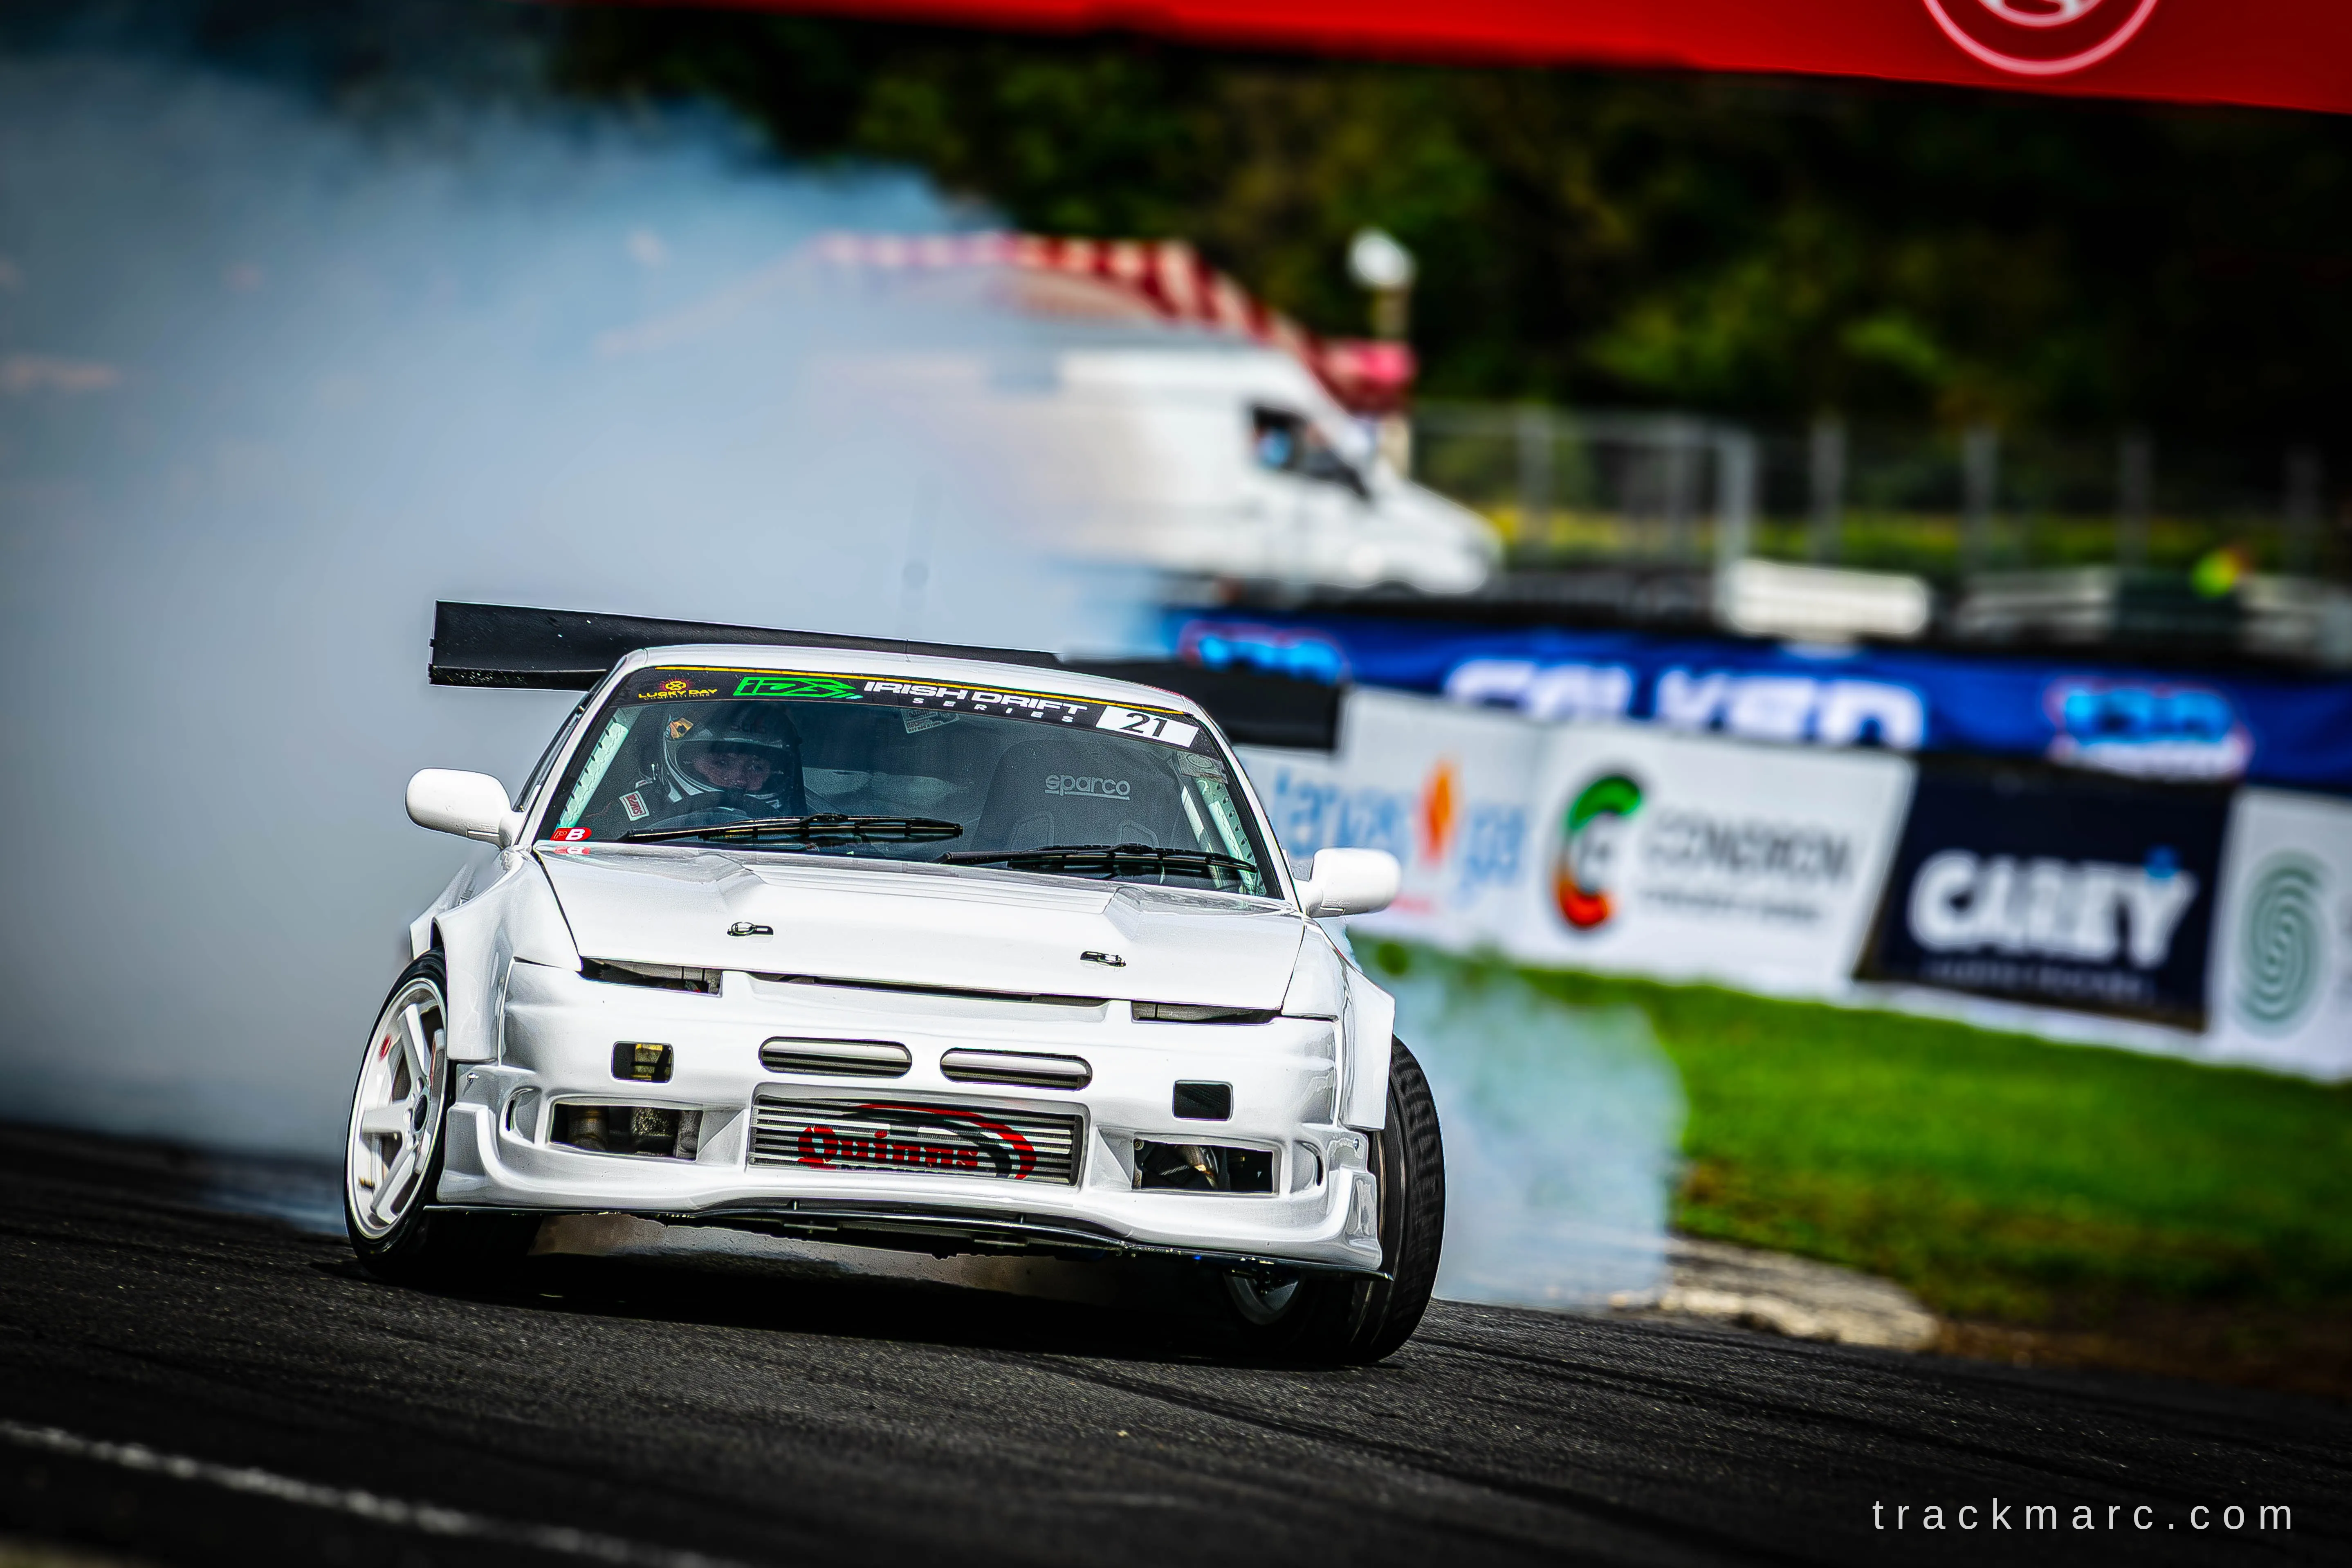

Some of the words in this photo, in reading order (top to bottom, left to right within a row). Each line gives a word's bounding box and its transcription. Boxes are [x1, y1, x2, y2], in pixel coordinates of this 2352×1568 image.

[638, 690, 686, 698] LUCKY
[864, 681, 968, 700] IRISH
[972, 691, 1088, 715] DRIFT
[912, 698, 1074, 722] SERIES
[1119, 713, 1167, 737] 21
[1046, 774, 1131, 796] sparco
